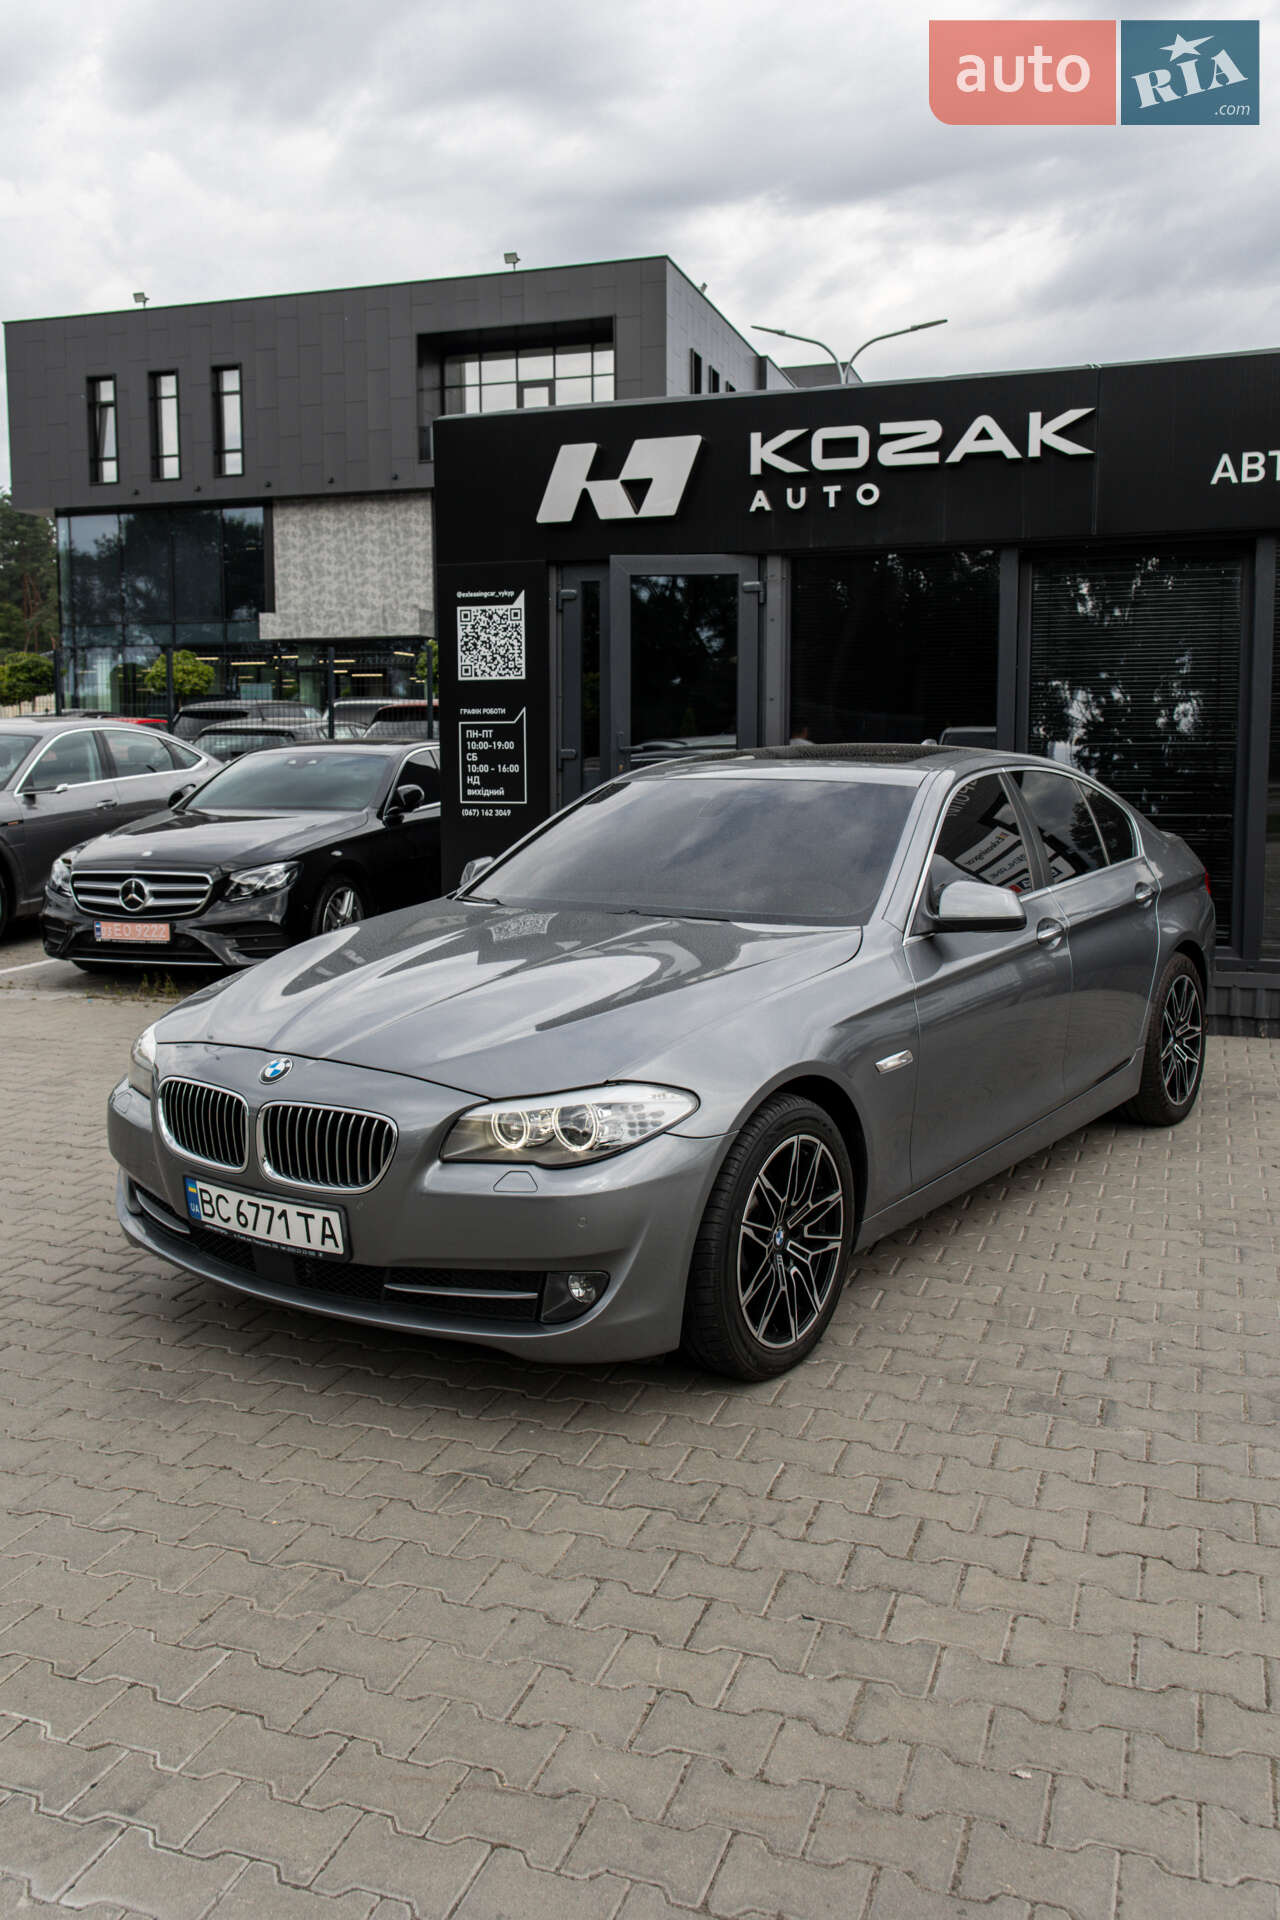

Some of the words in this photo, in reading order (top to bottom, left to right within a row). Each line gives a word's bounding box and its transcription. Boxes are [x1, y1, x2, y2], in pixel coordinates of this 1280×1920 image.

[750, 407, 1096, 475] KOZAK
[749, 483, 880, 512] AUTO
[466, 729, 493, 738] ПН-ПТ
[466, 741, 515, 750] 10:00-19:00
[466, 752, 478, 761] СБ
[467, 764, 489, 773] 10:00
[498, 764, 520, 773] 16:00
[467, 776, 480, 785] НД
[467, 787, 505, 796] вихідний
[461, 809, 480, 817] (067)
[481, 809, 493, 817] 162
[495, 809, 511, 817] 3049
[190, 1203, 200, 1214] UA
[198, 1187, 231, 1224] BC
[236, 1199, 291, 1240] 6771
[296, 1211, 340, 1249] TA
